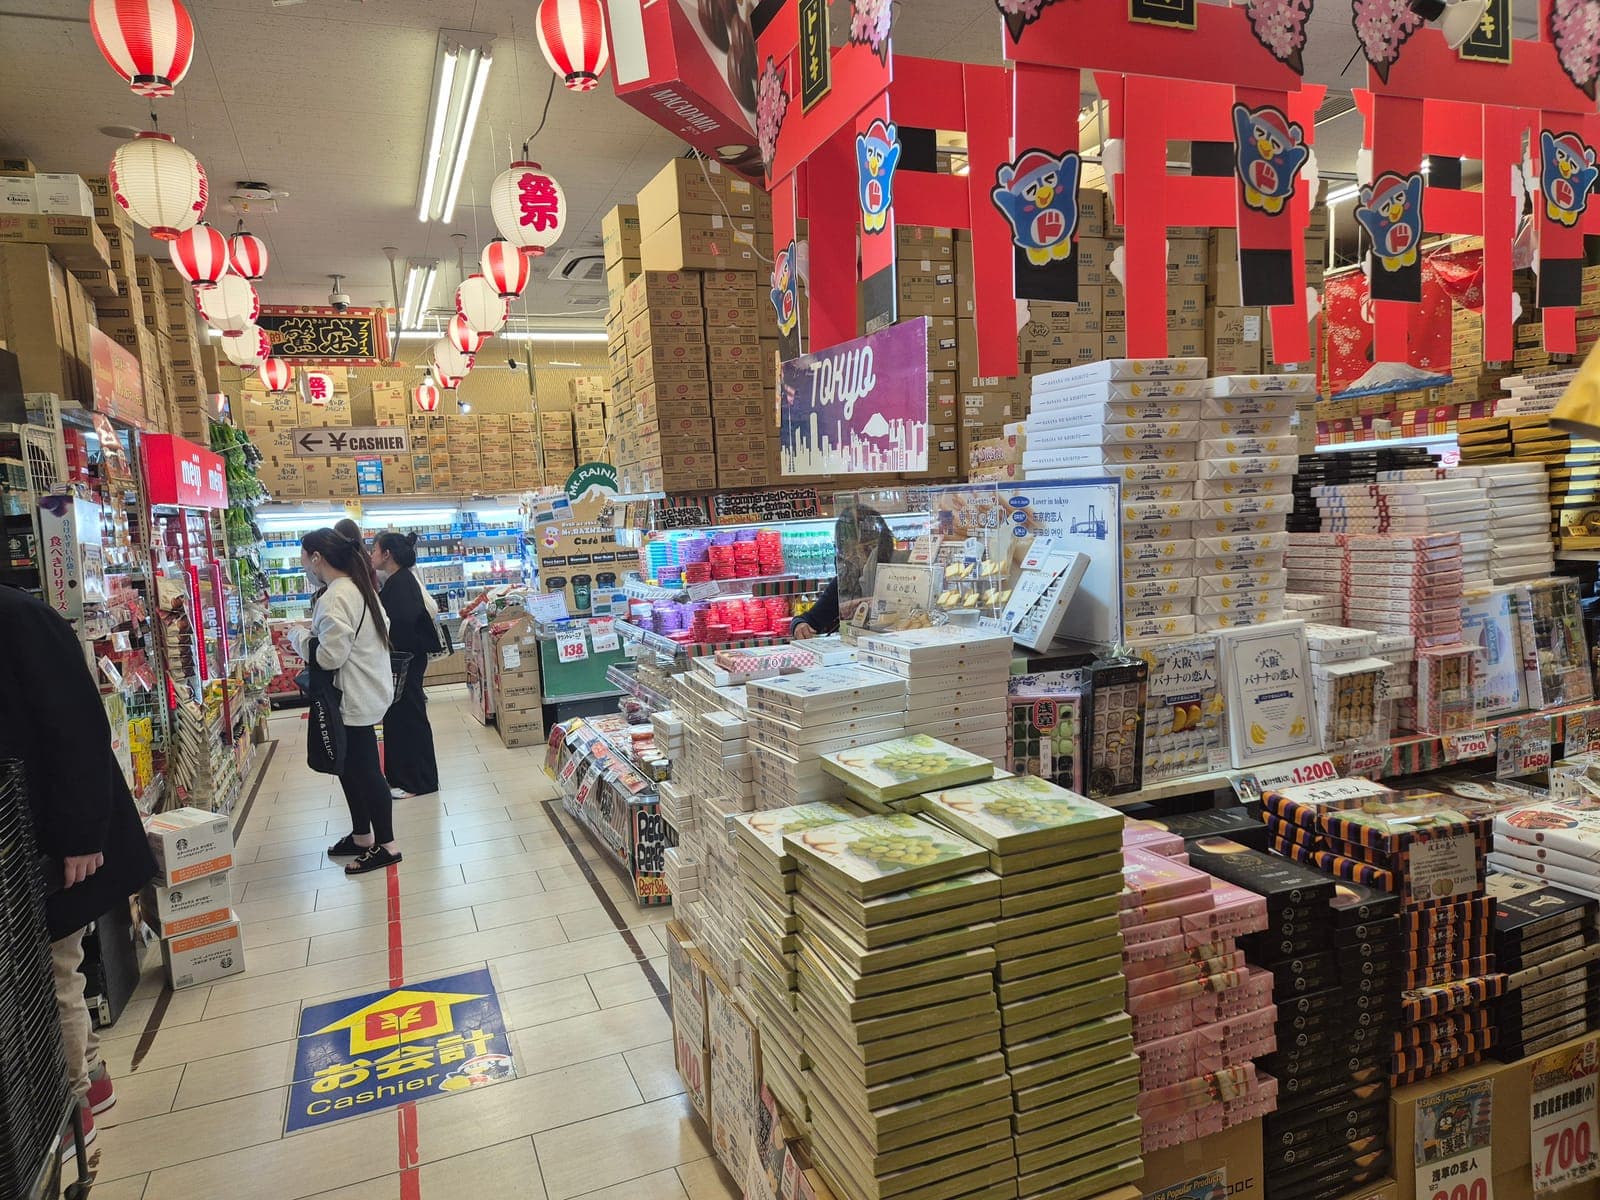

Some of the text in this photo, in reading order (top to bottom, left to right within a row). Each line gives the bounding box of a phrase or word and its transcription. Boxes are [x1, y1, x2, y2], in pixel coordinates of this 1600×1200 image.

[650, 89, 721, 133] MACADAMIA
[517, 172, 558, 232] 祭
[1037, 211, 1062, 244] ド
[358, 321, 370, 356] プライス
[309, 377, 326, 399] 祭
[810, 346, 876, 421] TOKYO
[349, 437, 404, 451] CASHIER
[181, 454, 202, 496] meiji
[208, 463, 223, 500] meiji
[714, 491, 780, 507] Recommended
[1054, 497, 1069, 507] tokyo
[775, 510, 791, 520] the
[958, 505, 1010, 528] 東京の恋人
[1032, 511, 1063, 522] 东京的恋人
[50, 536, 68, 611] 食べきりサイズ
[563, 643, 584, 657] 138
[1172, 656, 1192, 670] 大阪
[1260, 655, 1280, 669] 大阪
[1154, 669, 1212, 686] バナナの恋人
[1244, 667, 1300, 685] バナナの恋人
[1290, 761, 1334, 785] ¥1,200
[637, 844, 664, 871] Perfe
[639, 879, 655, 896] Best
[310, 1029, 495, 1095] お会計
[306, 1073, 441, 1116] Cashier
[1442, 1133, 1466, 1156] 浅草
[1432, 1158, 1478, 1183] 浅草の恋人
